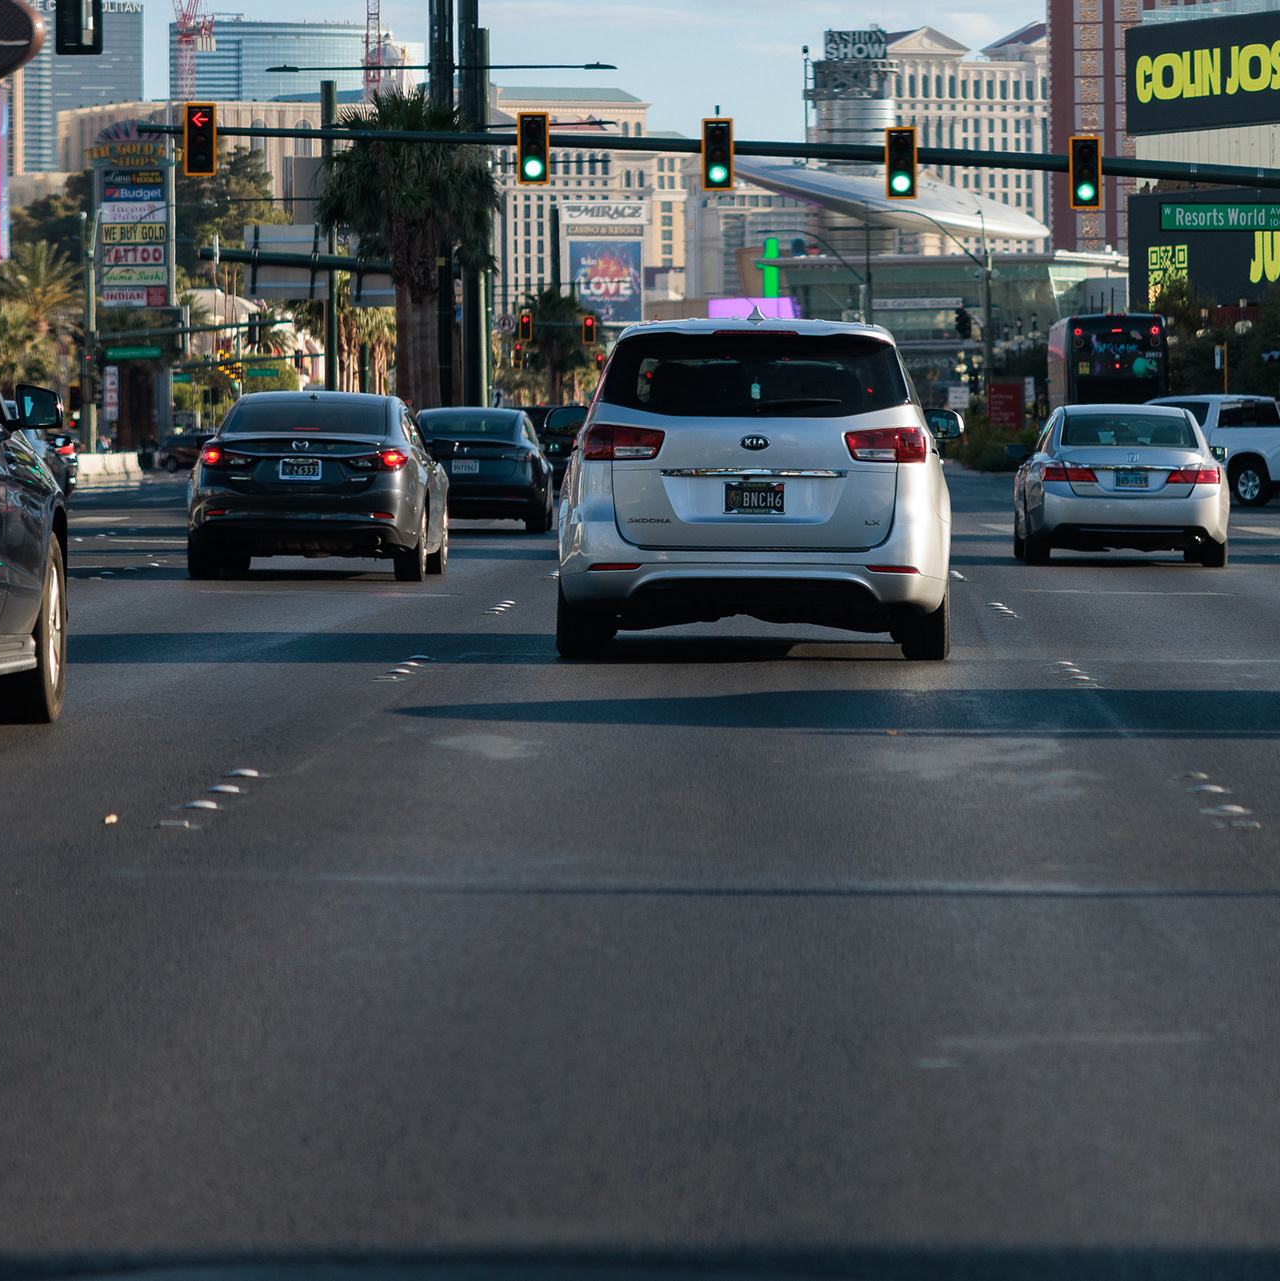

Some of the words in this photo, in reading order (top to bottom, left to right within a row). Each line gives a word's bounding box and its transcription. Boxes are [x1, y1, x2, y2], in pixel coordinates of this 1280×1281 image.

[826, 31, 886, 43] FASHION
[826, 43, 886, 59] SHOW
[1135, 47, 1221, 104] COLIN
[115, 142, 153, 156] GOLD
[111, 157, 158, 167] SHOPS
[120, 188, 162, 200] Budget
[569, 204, 642, 219] MIRAGE
[1164, 207, 1172, 215] W
[1176, 208, 1224, 226] Resorts
[1227, 207, 1266, 226] World
[104, 226, 117, 240] WE
[120, 225, 138, 240] BUY
[141, 225, 165, 240] GOLD
[568, 225, 599, 234] CASINO
[600, 226, 607, 234] &
[608, 225, 641, 234] RESORT
[104, 247, 162, 263] TATTOO
[580, 276, 633, 295] LOVE
[106, 292, 144, 300] INDIAN
[744, 438, 765, 447] KIA
[743, 492, 782, 507] BNCH6
